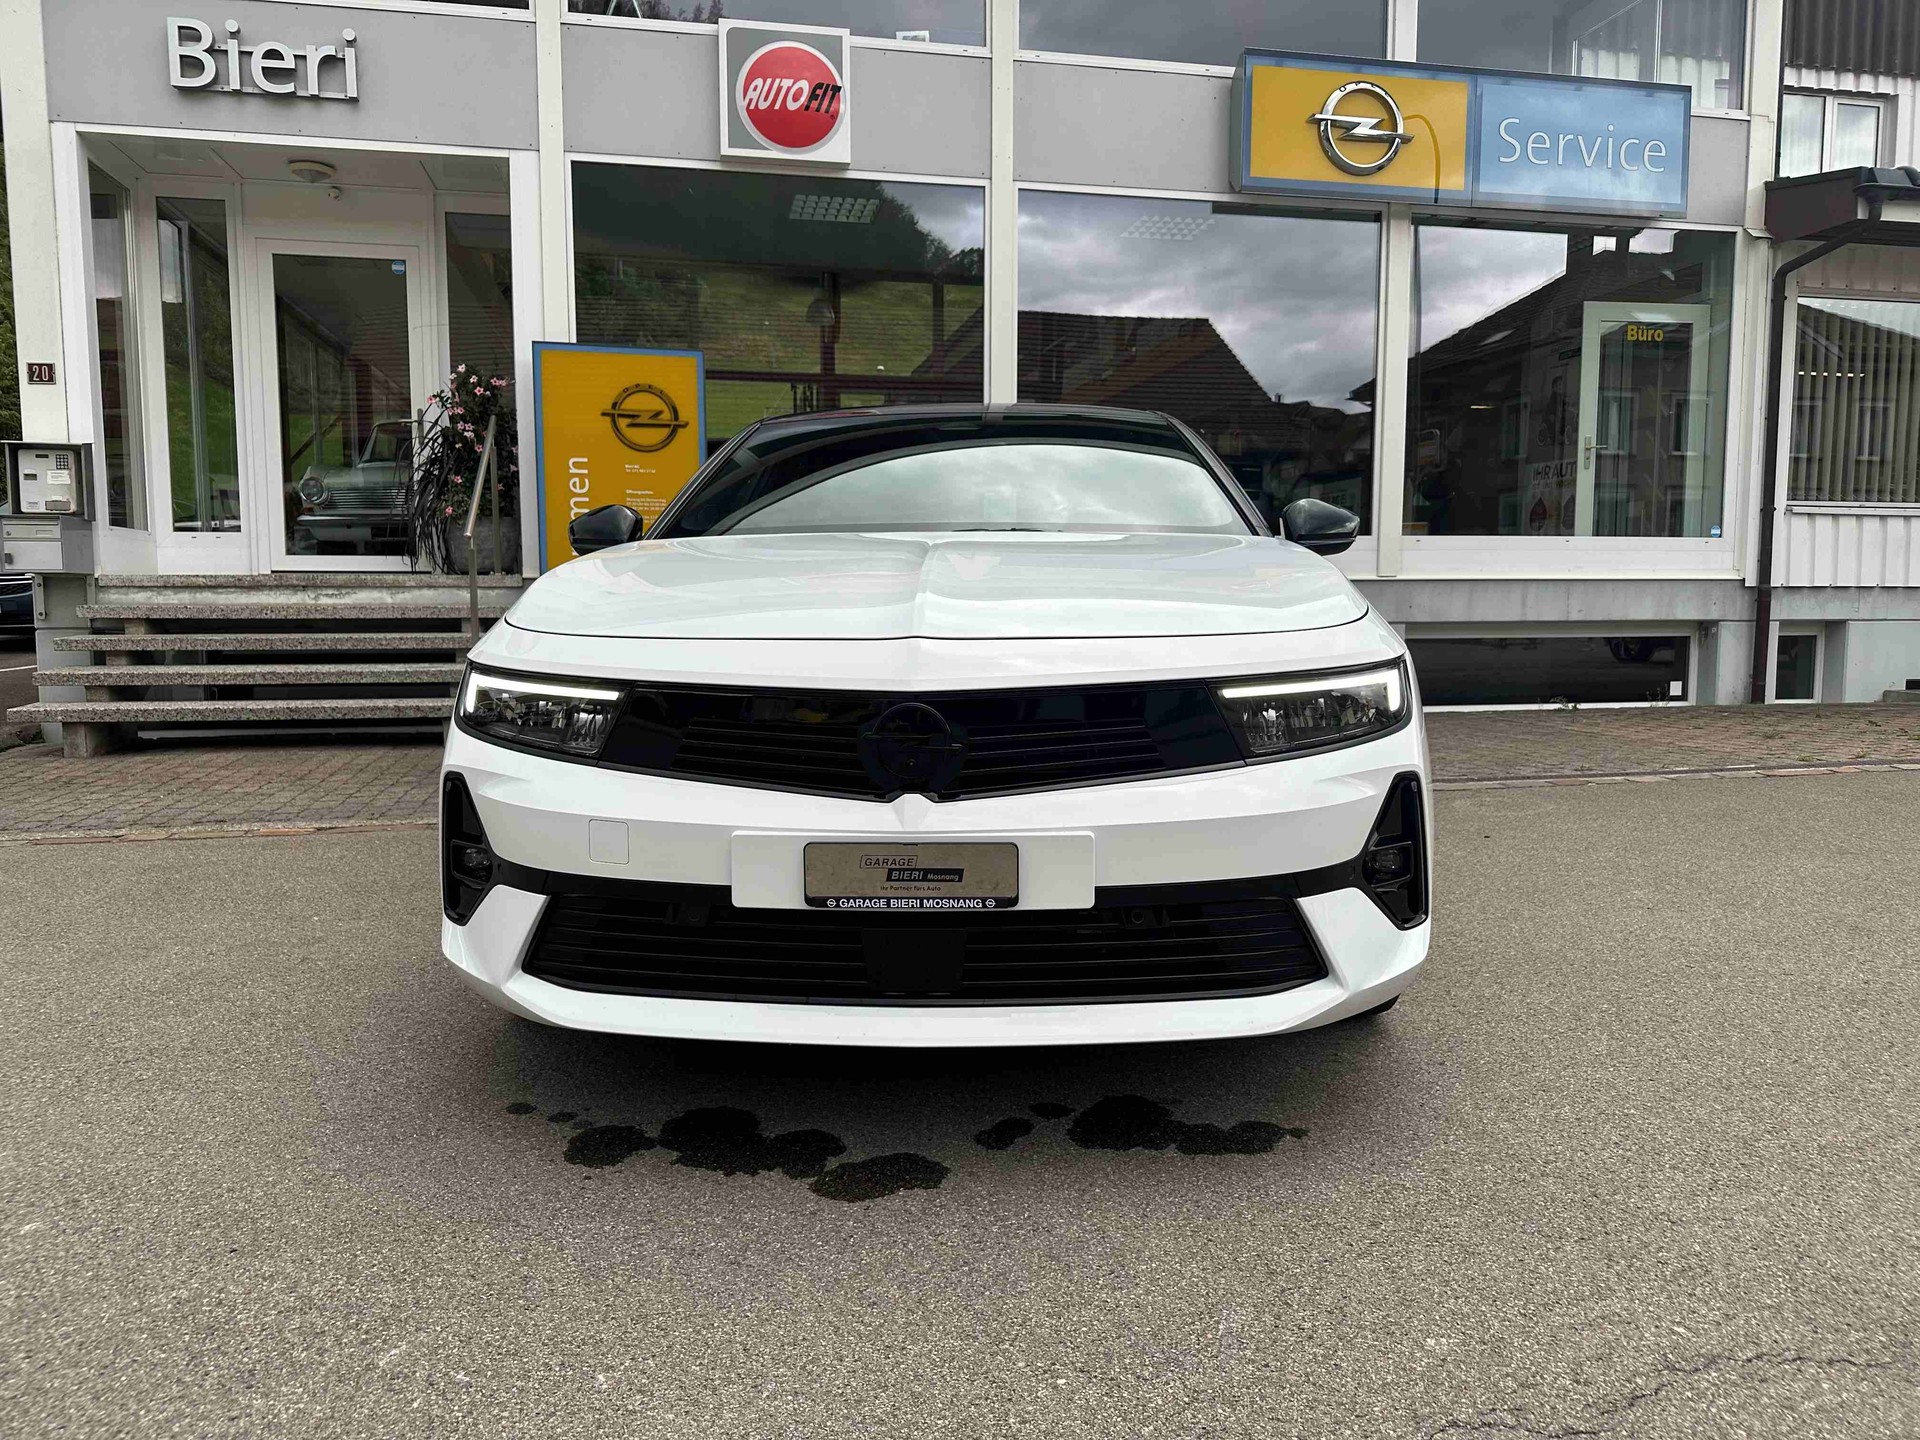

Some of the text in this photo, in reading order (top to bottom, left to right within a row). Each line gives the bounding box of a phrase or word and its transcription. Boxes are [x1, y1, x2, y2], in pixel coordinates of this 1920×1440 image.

[167, 16, 358, 98] Bieri
[1498, 117, 1667, 173] Service
[1626, 325, 1664, 342] Büro
[32, 365, 49, 381] 20
[864, 857, 915, 867] GARAGE
[891, 871, 959, 882] BIERI Mosnang
[839, 899, 983, 908] GARAGE BIERI MOSNANG
